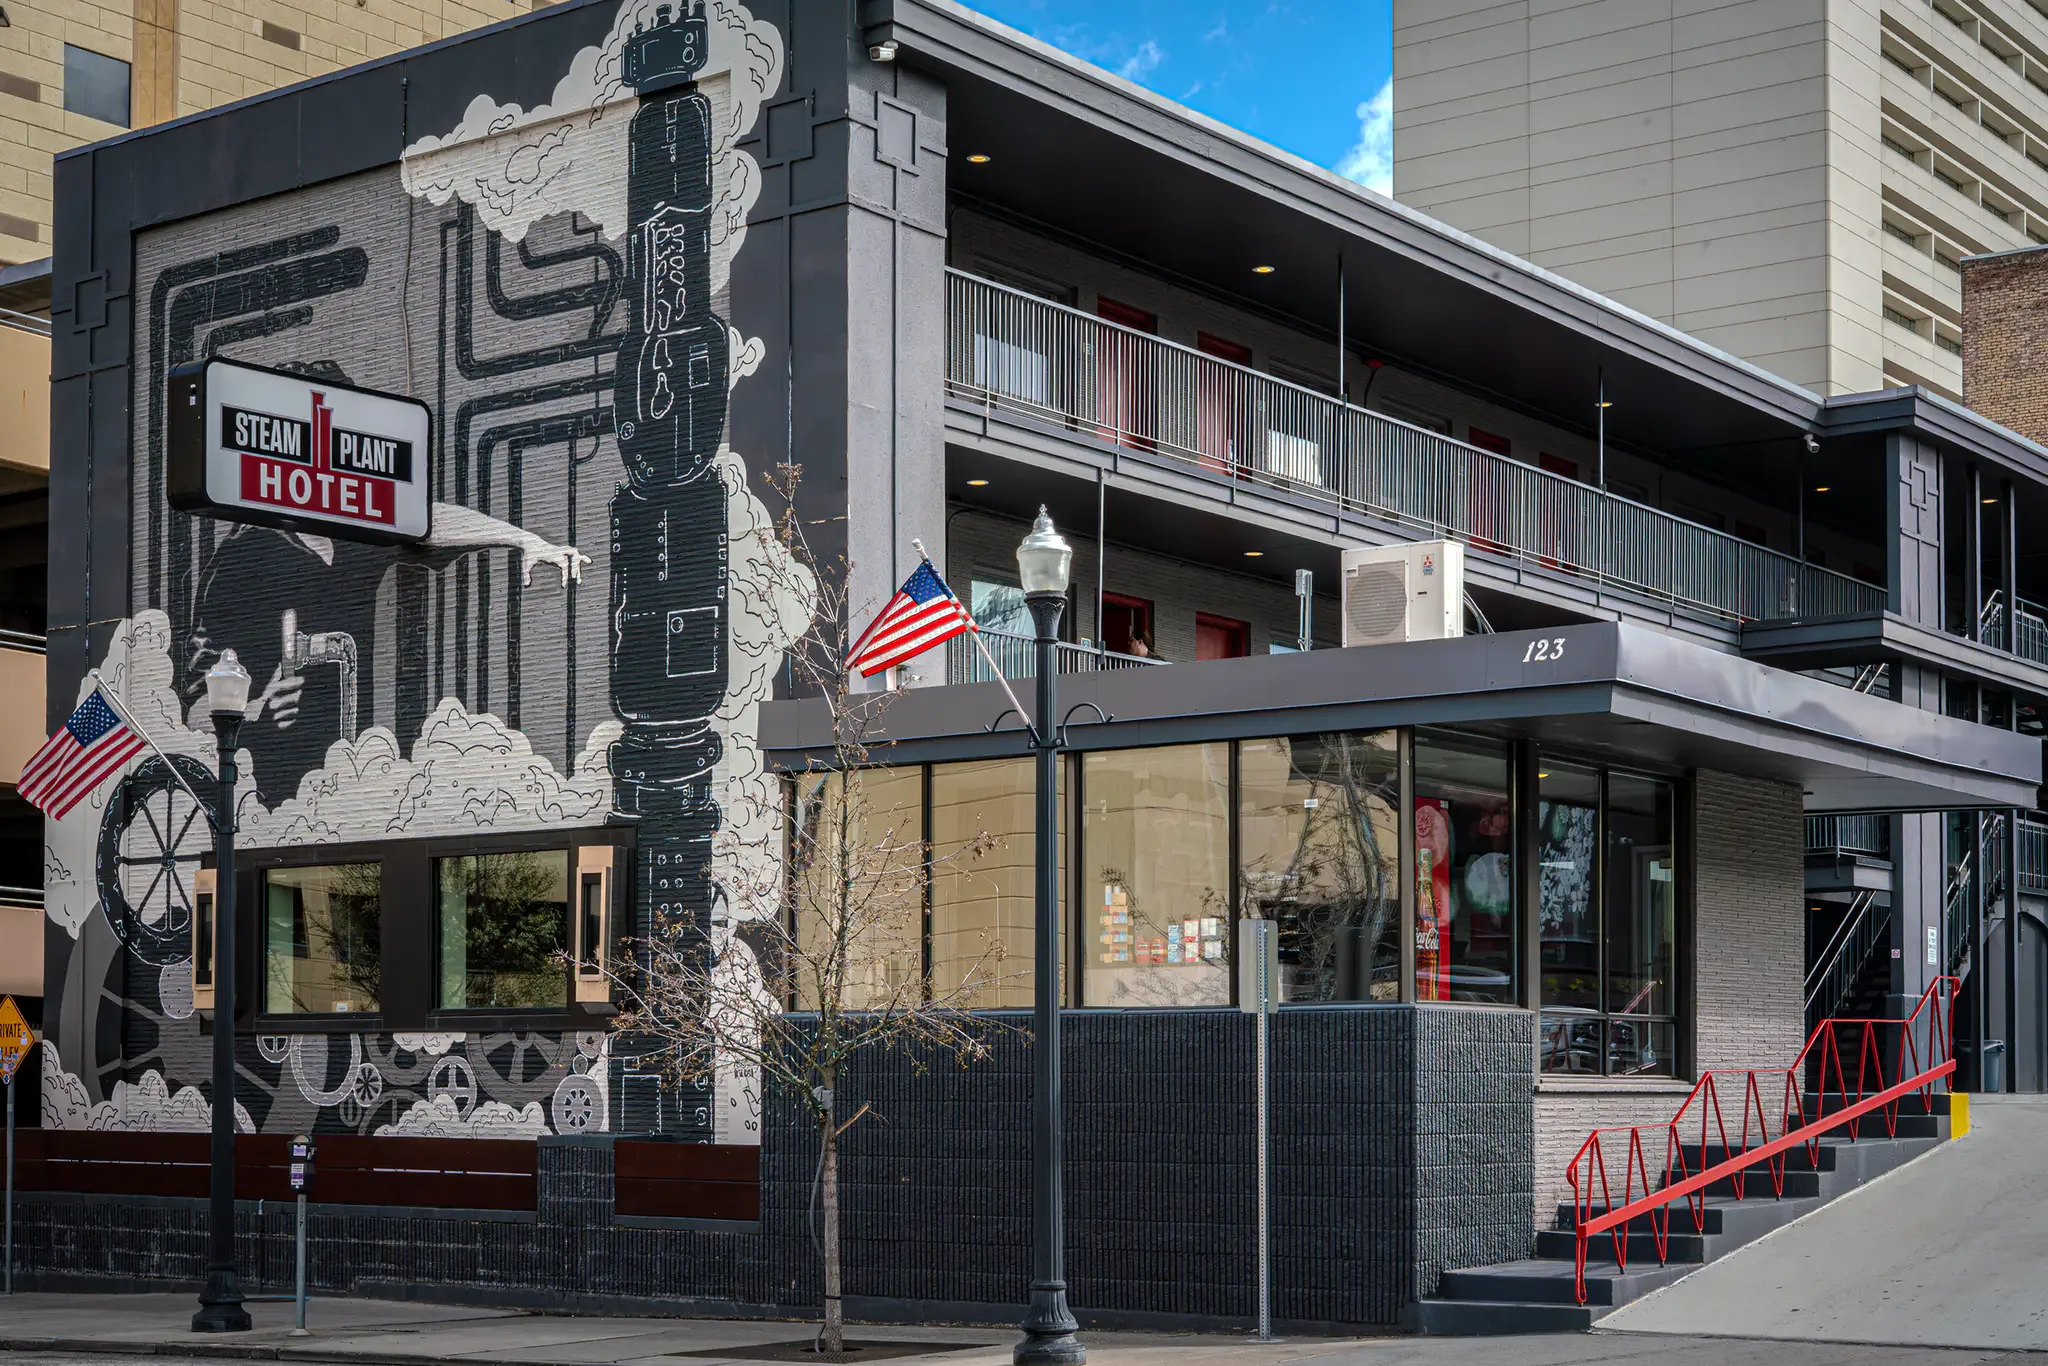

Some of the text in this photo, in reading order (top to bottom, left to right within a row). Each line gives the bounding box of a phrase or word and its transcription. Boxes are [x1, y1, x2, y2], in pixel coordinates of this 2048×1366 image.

[235, 412, 397, 473] STEAM PLANT
[260, 463, 382, 518] HOTEL
[1522, 637, 1566, 663] 123
